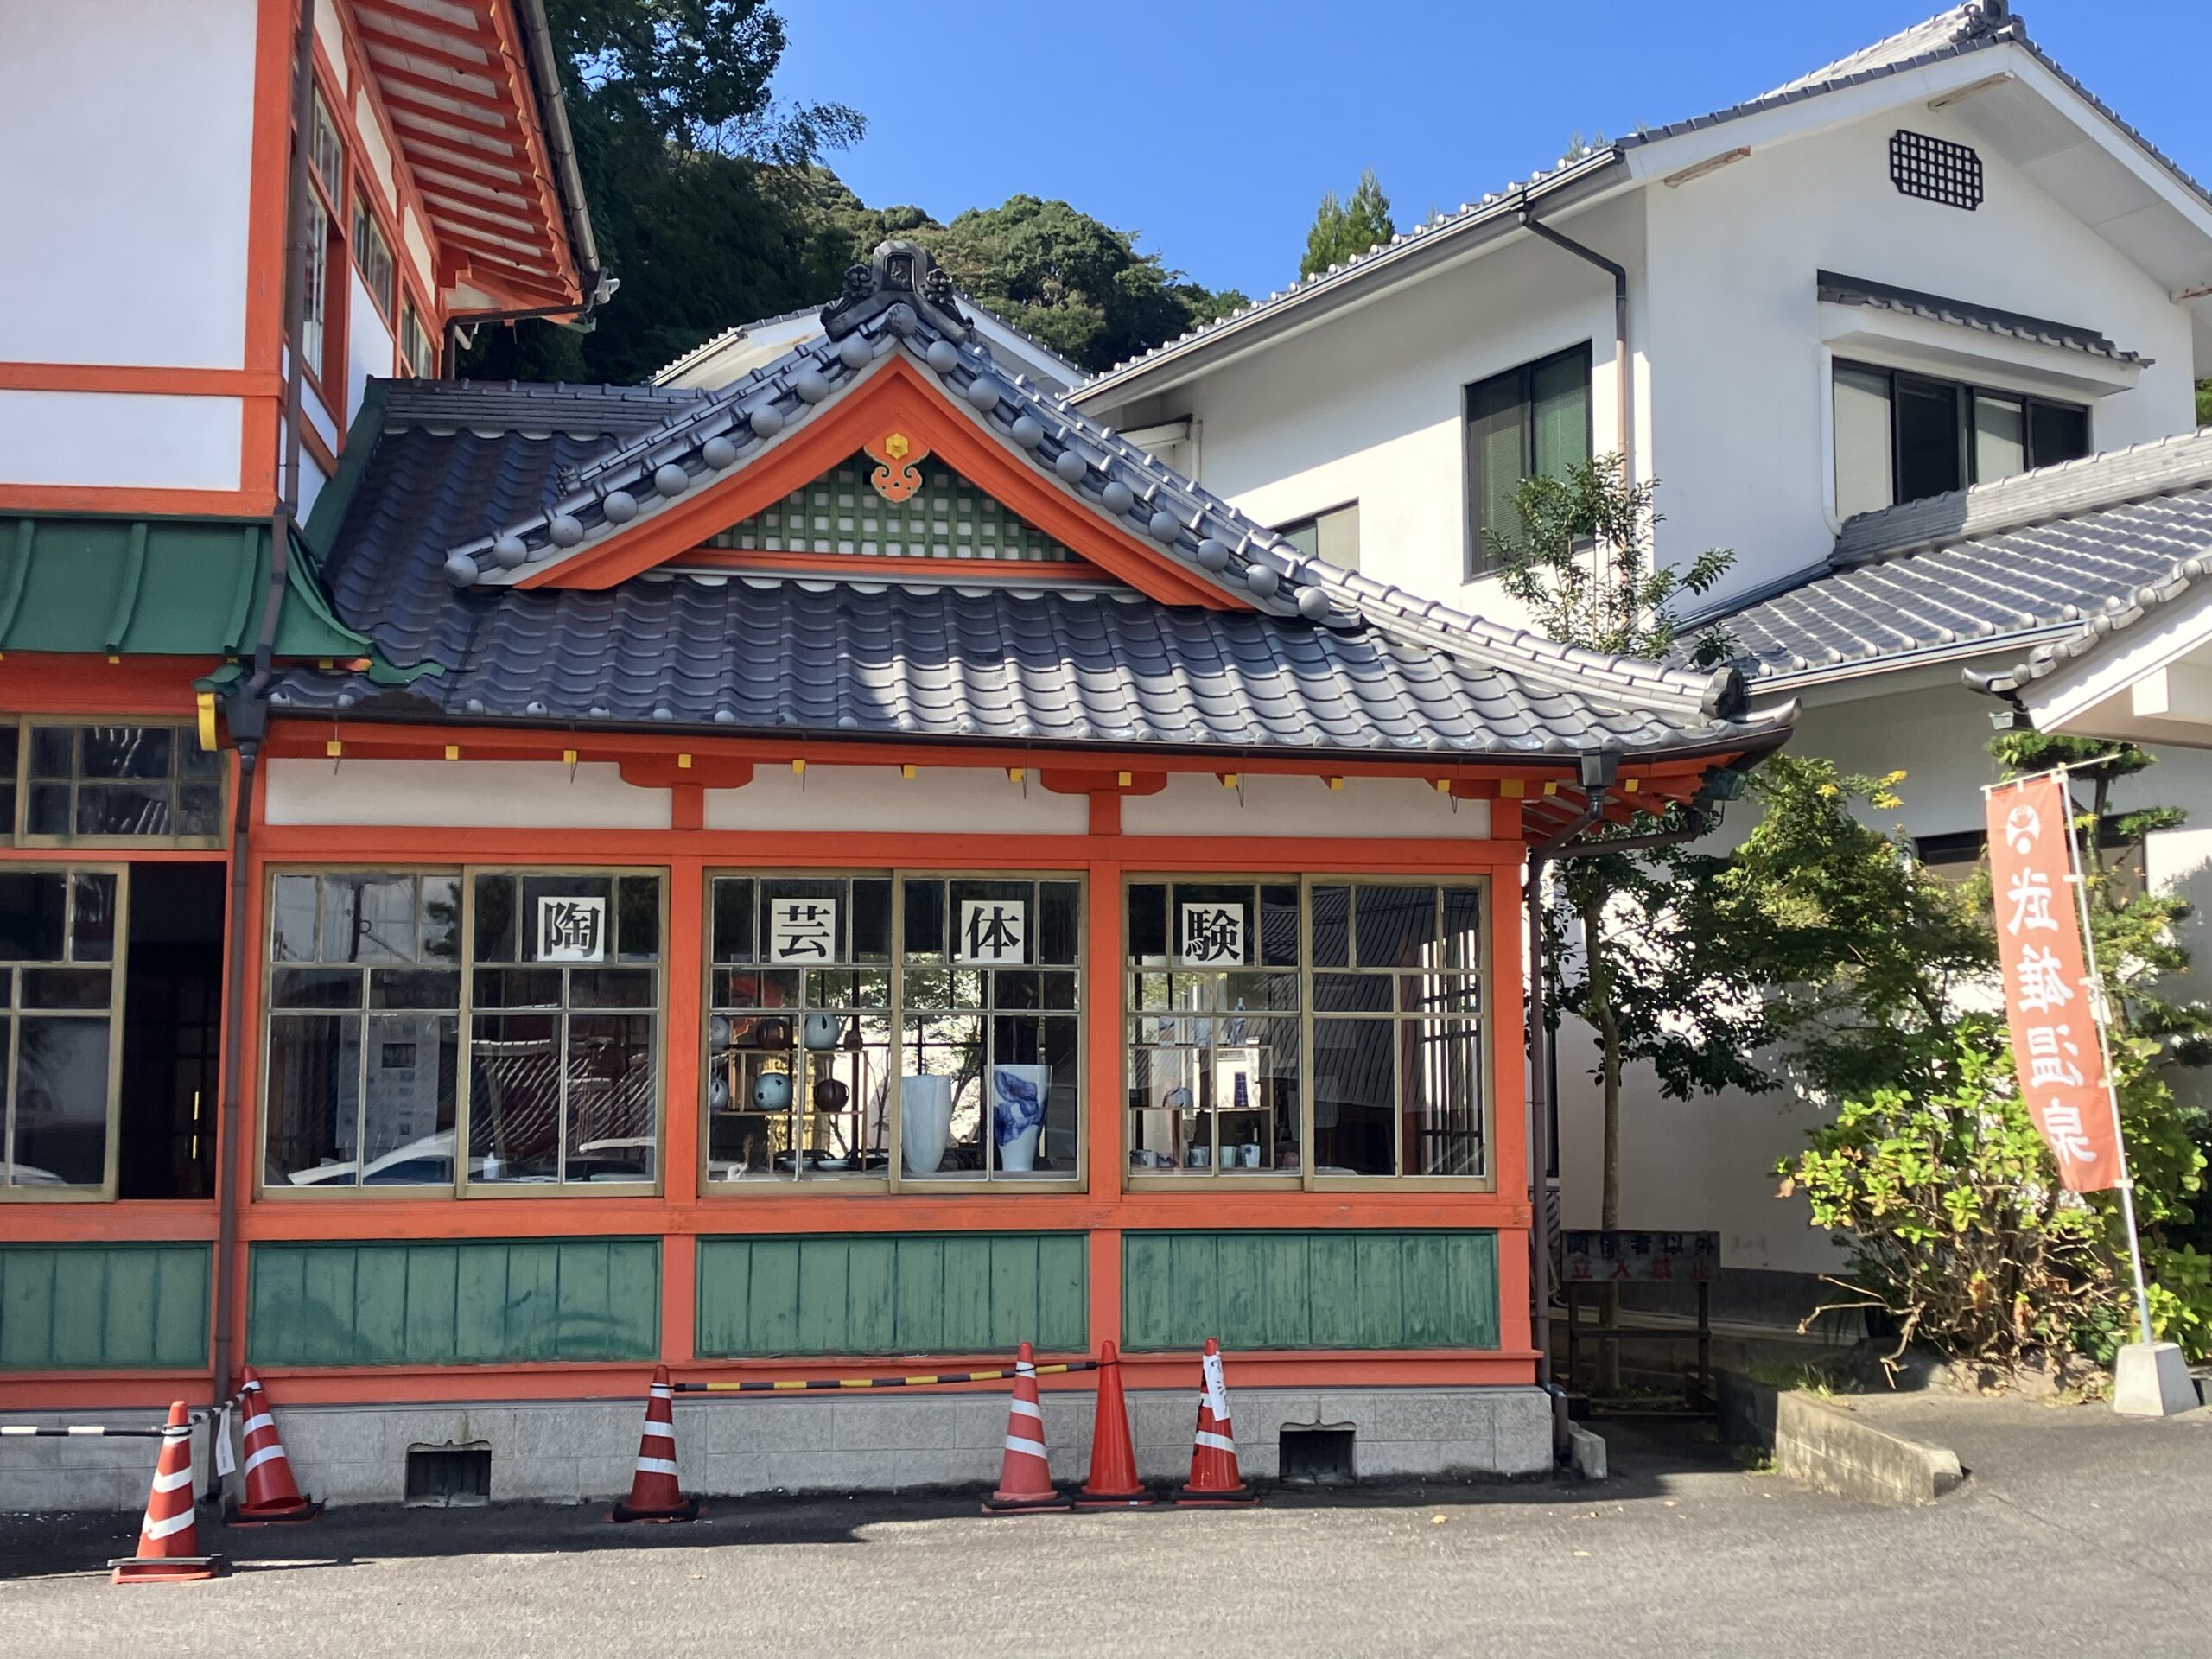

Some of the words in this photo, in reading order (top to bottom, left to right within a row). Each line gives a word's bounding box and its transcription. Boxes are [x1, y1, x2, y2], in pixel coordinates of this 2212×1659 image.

[544, 903, 601, 957] 陶
[777, 905, 831, 958] 芸
[966, 906, 1020, 959] 体
[1185, 908, 1241, 962] 験
